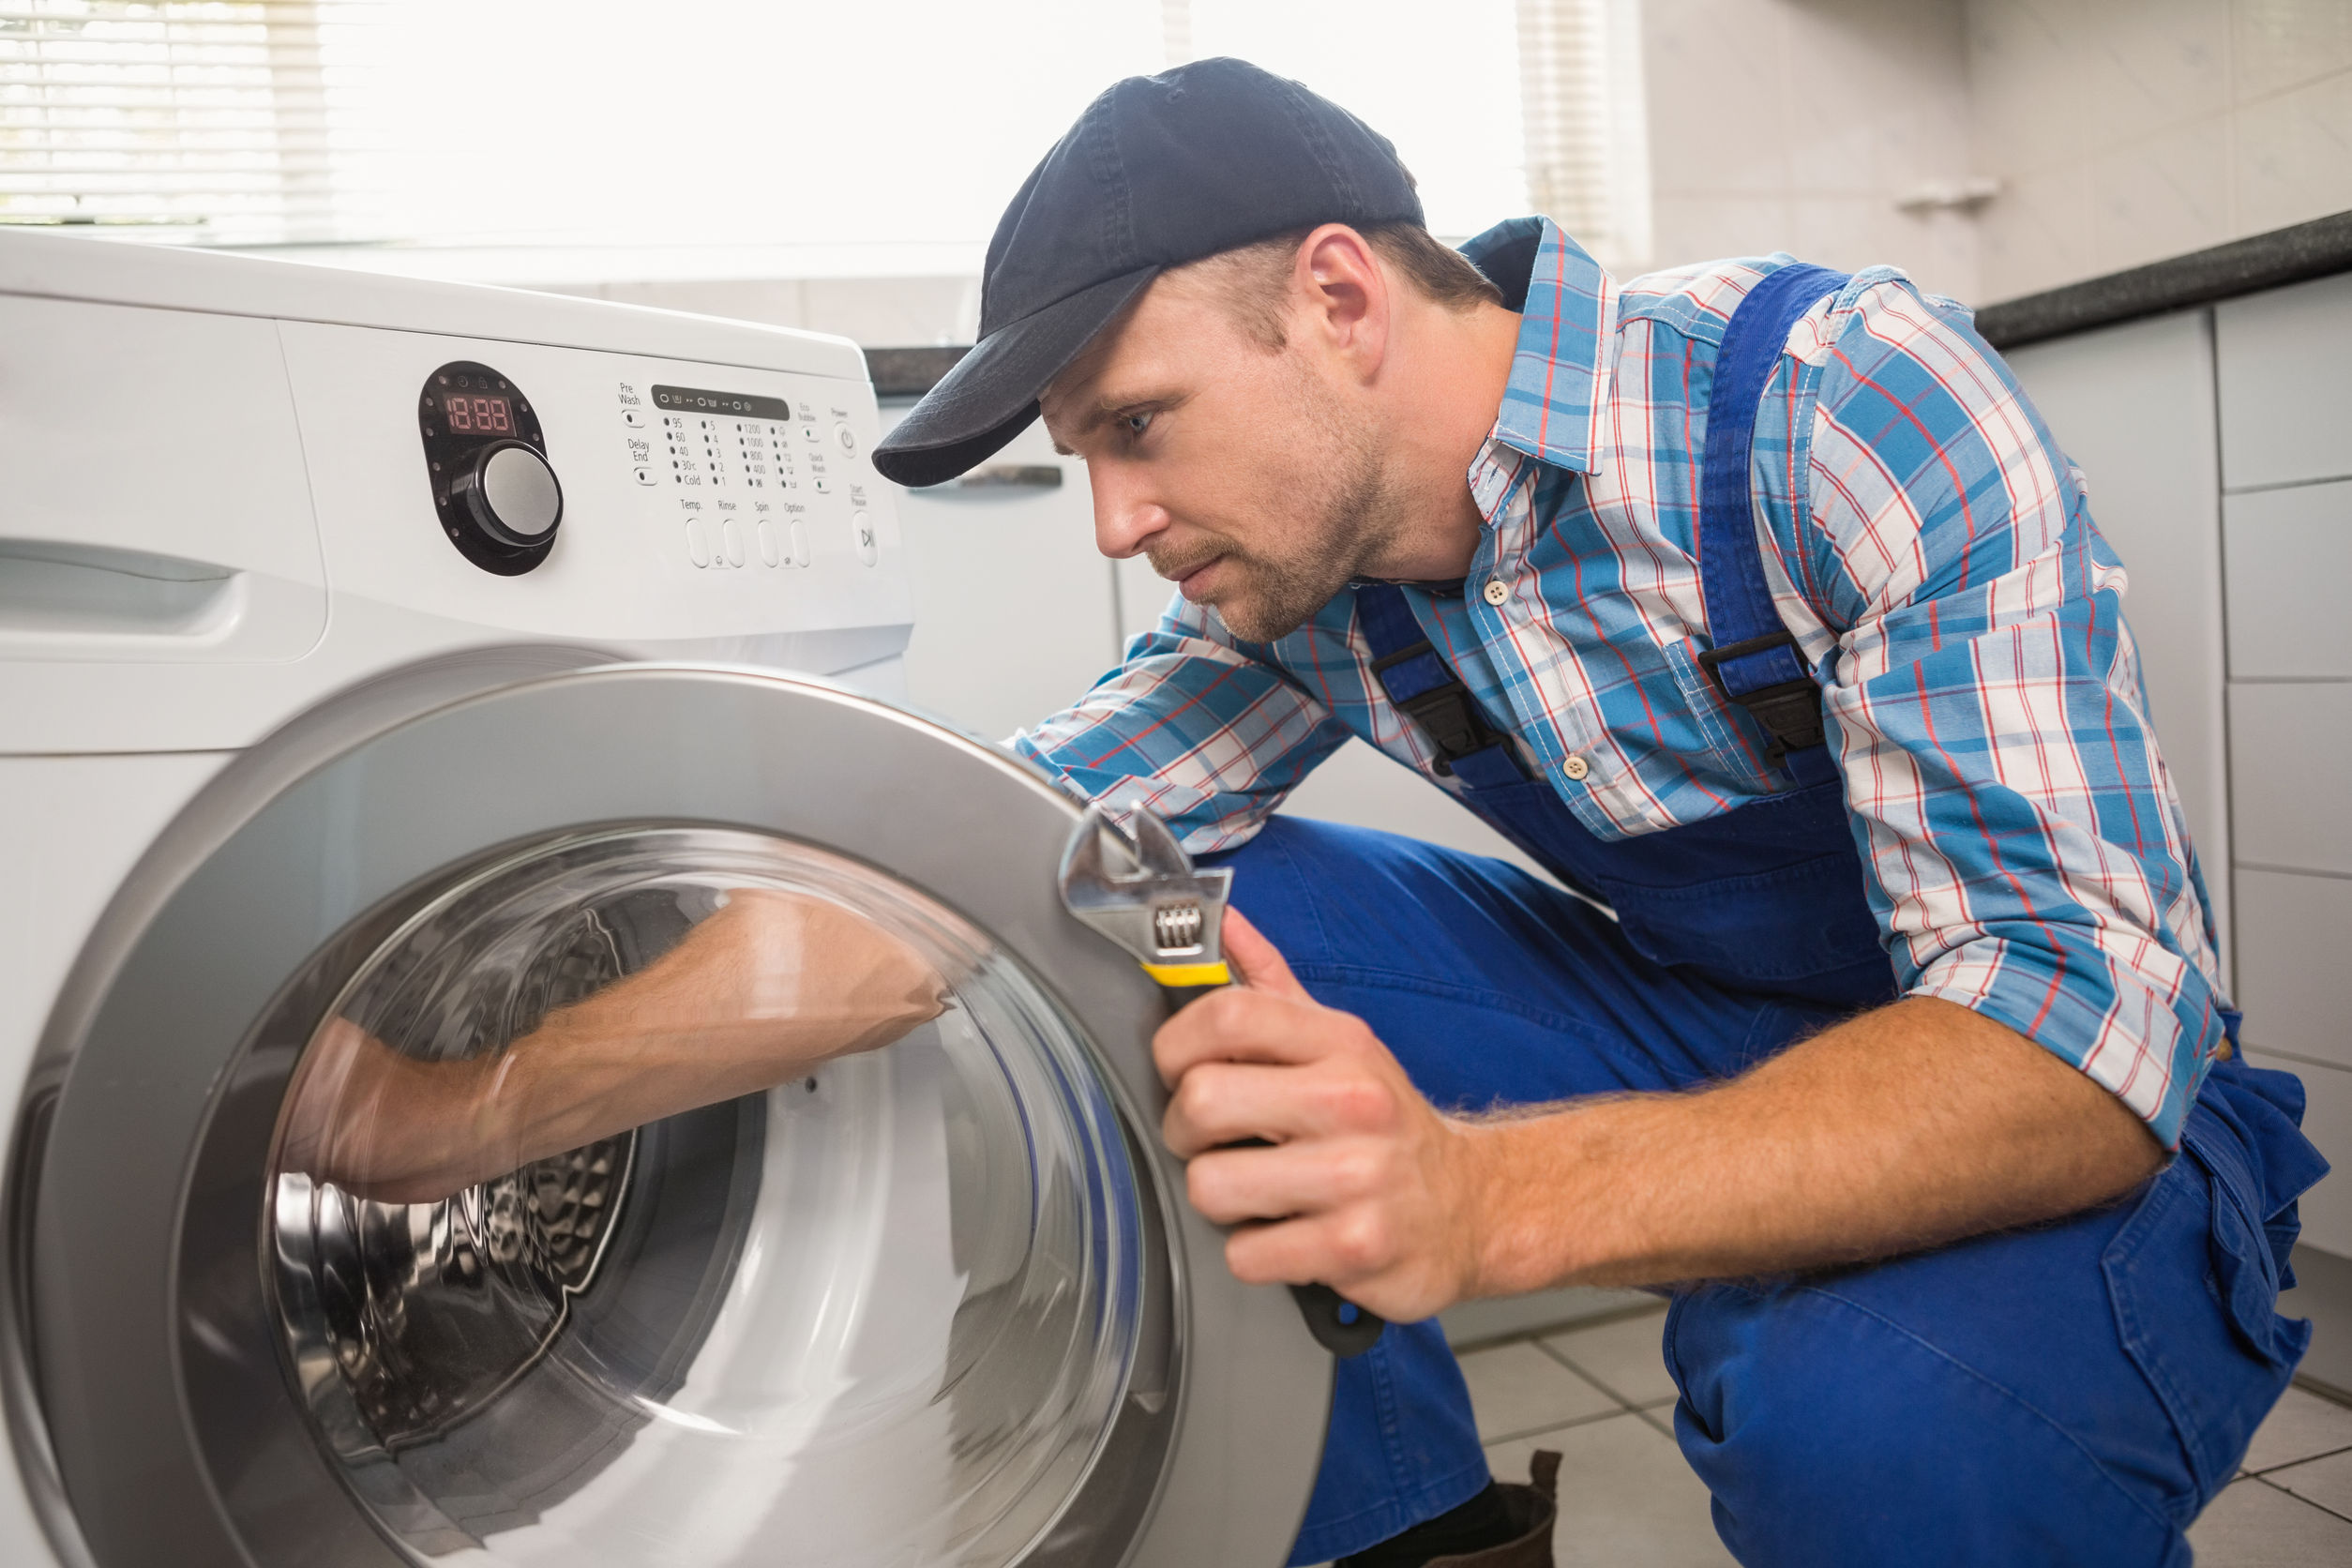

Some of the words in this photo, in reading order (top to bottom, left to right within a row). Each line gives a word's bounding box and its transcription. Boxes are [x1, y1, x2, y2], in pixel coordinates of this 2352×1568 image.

[619, 382, 633, 393] Pre
[619, 394, 641, 405] Wash
[673, 418, 682, 428] 95
[710, 420, 716, 431] 5
[745, 424, 761, 435] 1200
[675, 432, 686, 443] 60
[714, 434, 718, 444] 4
[747, 437, 763, 448] 1000
[628, 438, 649, 452] Delay
[633, 451, 648, 461] End
[679, 446, 689, 457] 40
[716, 448, 722, 459] 3
[749, 451, 763, 461] 800
[719, 462, 725, 473] 2
[753, 464, 766, 475] 400
[685, 475, 701, 486] Cold
[680, 499, 703, 512] Temp.
[718, 500, 736, 511] Rinse
[754, 502, 769, 513] Spin
[784, 504, 805, 514] Option
